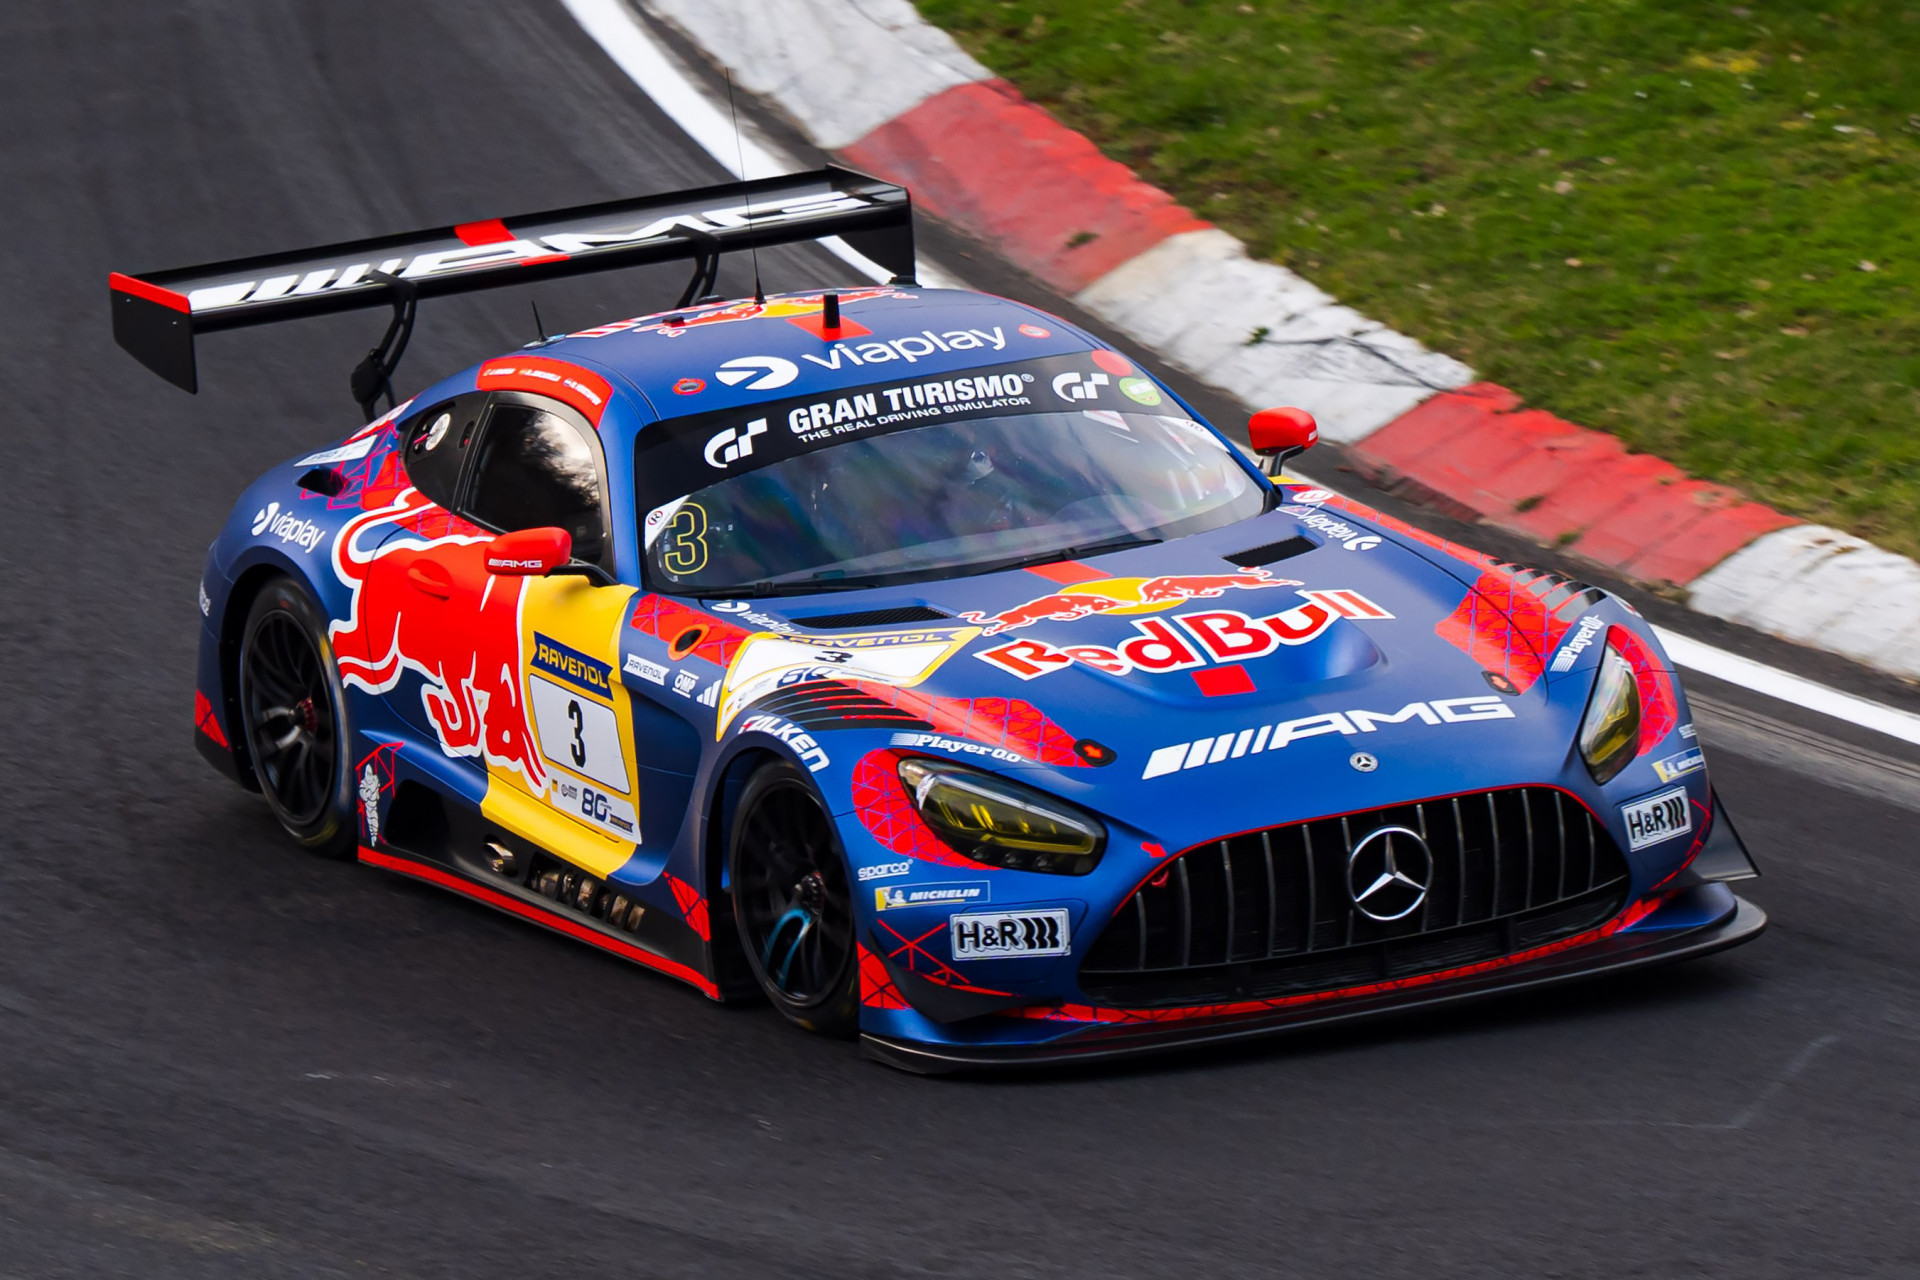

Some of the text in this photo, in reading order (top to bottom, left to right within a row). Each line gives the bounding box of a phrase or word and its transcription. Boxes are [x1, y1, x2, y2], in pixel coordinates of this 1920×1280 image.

[801, 325, 1006, 371] viaplay
[788, 393, 878, 435] GRAN
[798, 396, 1032, 443] THE REAL DRIVING SIMULATOR
[270, 511, 326, 554] viaplay
[664, 502, 708, 575] 3
[1297, 514, 1358, 541] viaplay
[501, 558, 543, 569] AMG
[973, 589, 1396, 681] Red Bull
[537, 643, 609, 689] RAVENOL
[628, 659, 663, 680] RAVENOL
[814, 650, 853, 663] 3
[674, 672, 697, 695] OMP
[567, 699, 587, 769] 3
[915, 733, 992, 753] Player
[1270, 696, 1516, 748] AMG
[737, 715, 830, 773] FALKEN
[1627, 804, 1667, 839] H&R
[909, 888, 981, 901] MICHELIN
[957, 919, 1019, 951] H&R
